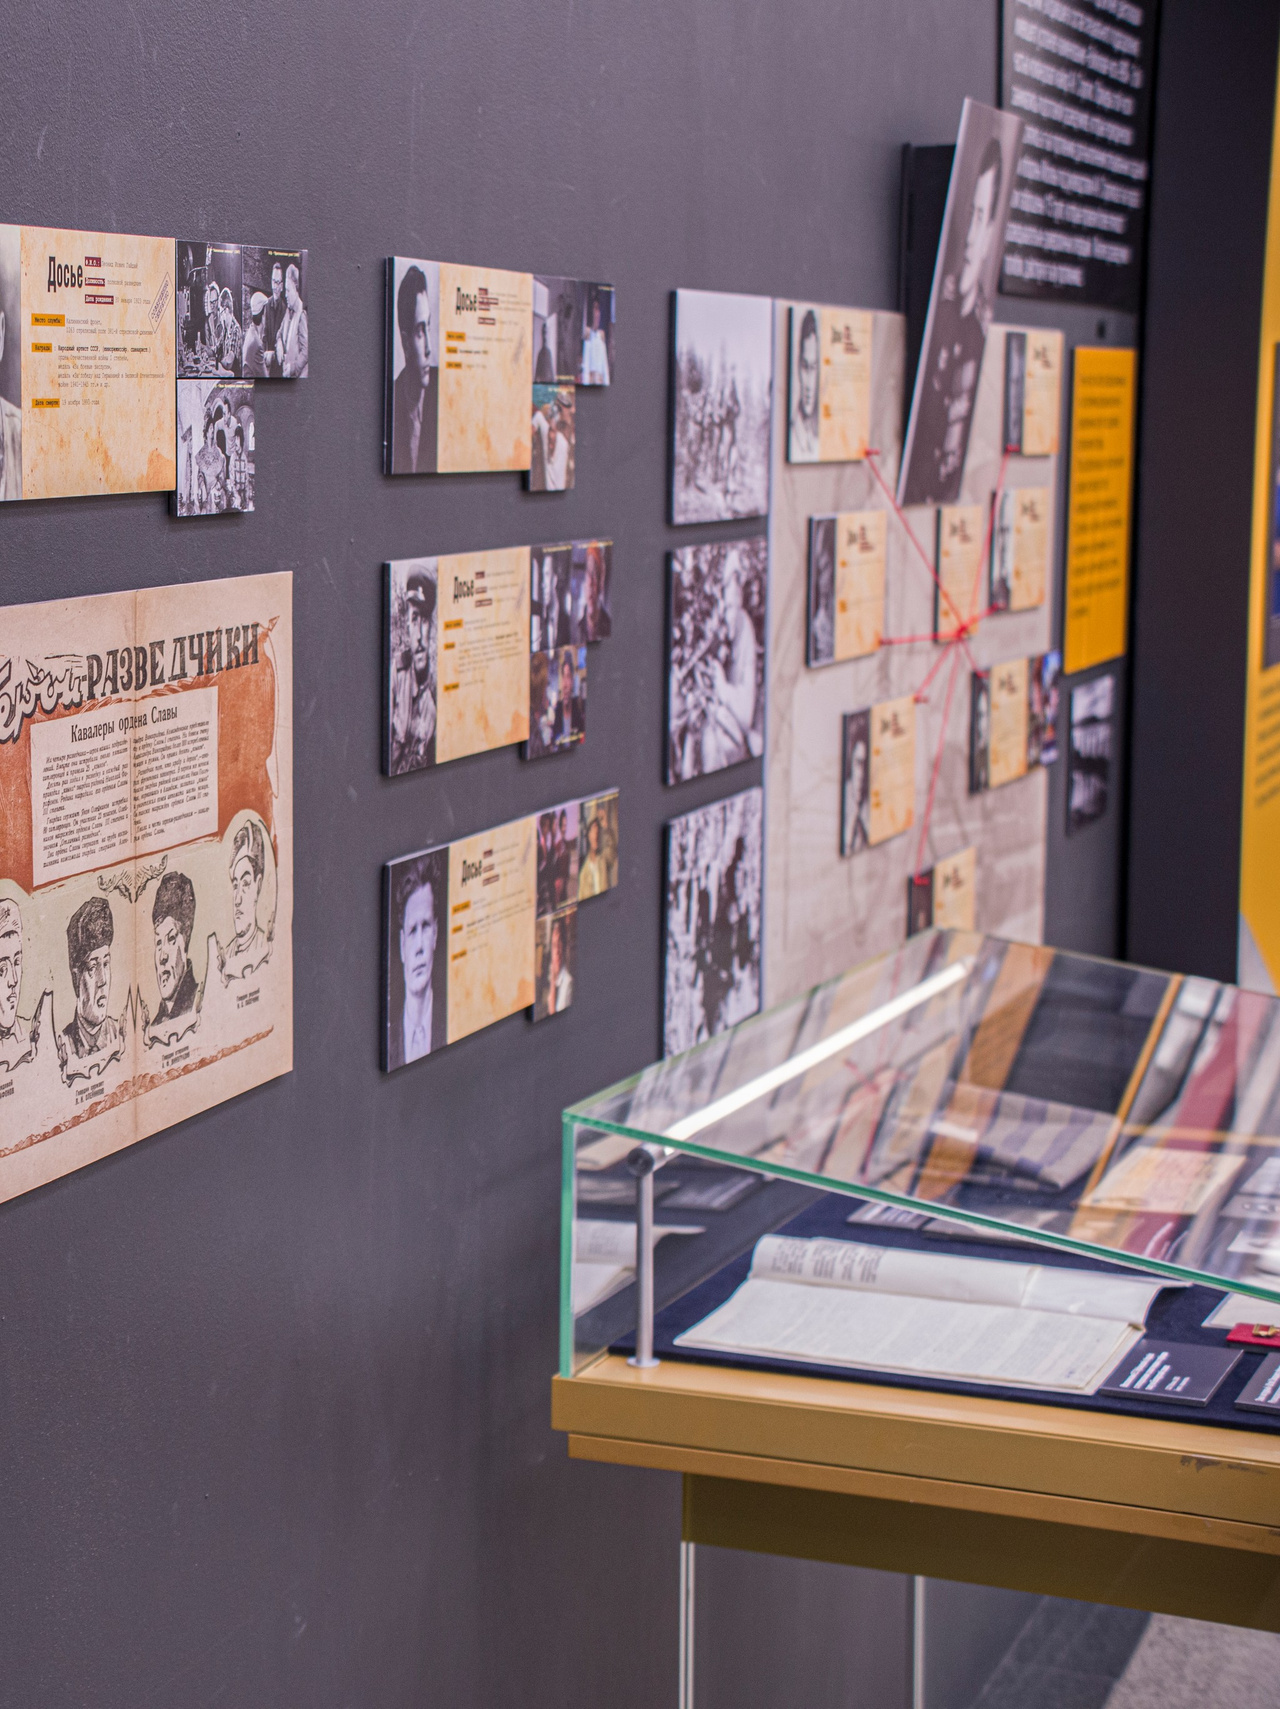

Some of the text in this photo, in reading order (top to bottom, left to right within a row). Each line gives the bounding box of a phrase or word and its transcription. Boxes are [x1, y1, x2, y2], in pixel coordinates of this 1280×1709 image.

[47, 256, 83, 293] Досье
[455, 287, 477, 315] Досье
[453, 576, 474, 604] Досье
[71, 705, 178, 743] Кавалеры ордена Славы
